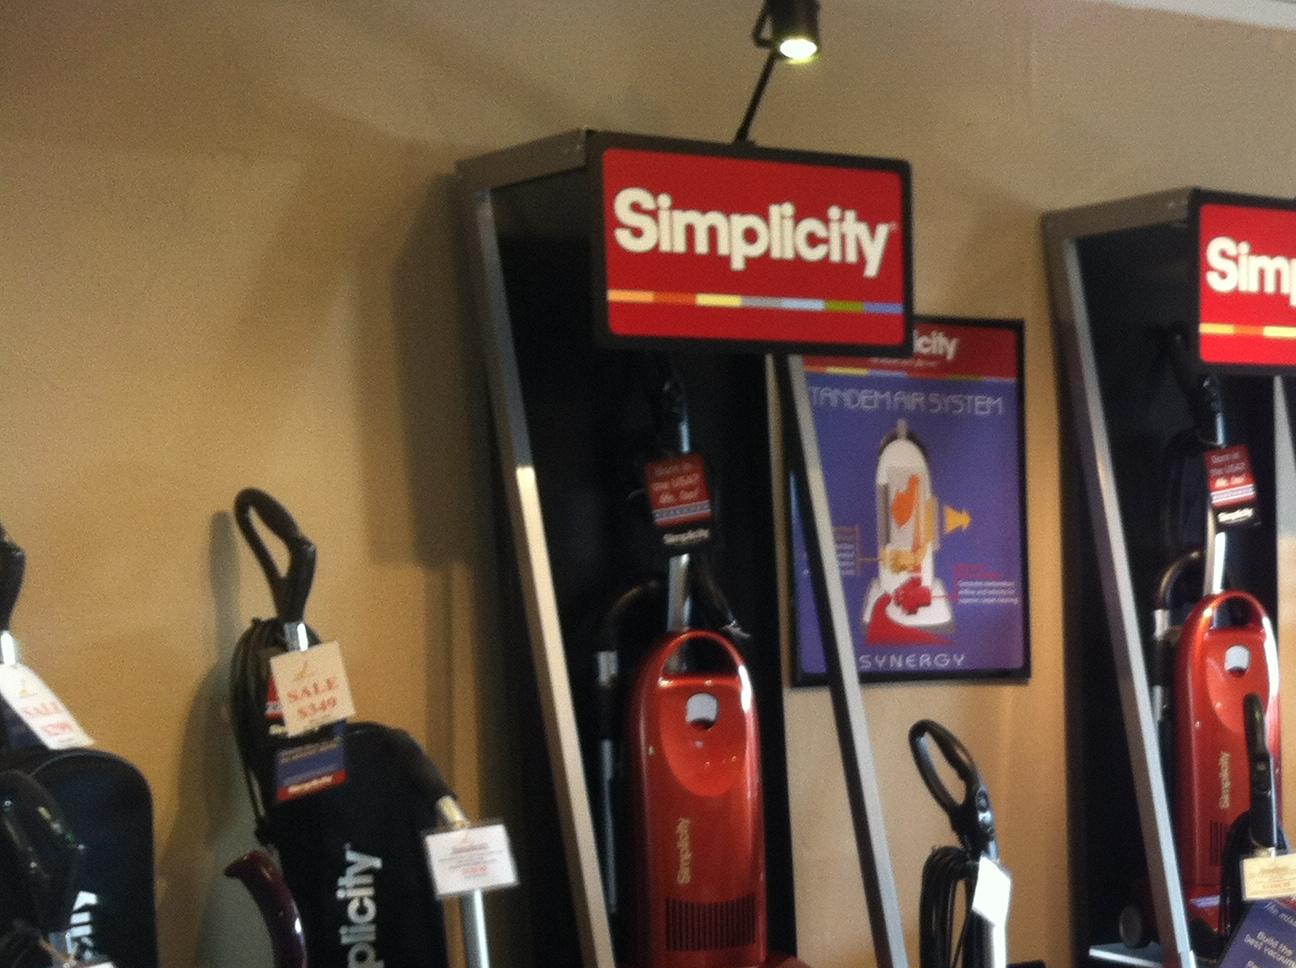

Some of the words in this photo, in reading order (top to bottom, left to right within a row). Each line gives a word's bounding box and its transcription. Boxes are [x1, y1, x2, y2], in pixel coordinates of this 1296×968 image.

[613, 187, 890, 278] Simplicity
[912, 329, 960, 360] icity
[809, 386, 891, 410] TANDEM
[892, 392, 927, 411] AIR
[929, 393, 1004, 415] SYSTEM
[858, 653, 966, 669] SYNERGY
[287, 678, 338, 703] SALE
[1218, 751, 1231, 810] Simplicity
[676, 817, 693, 885] Simplicity
[1263, 901, 1280, 916] The
[1256, 931, 1280, 949] Build
[1279, 943, 1294, 957] the
